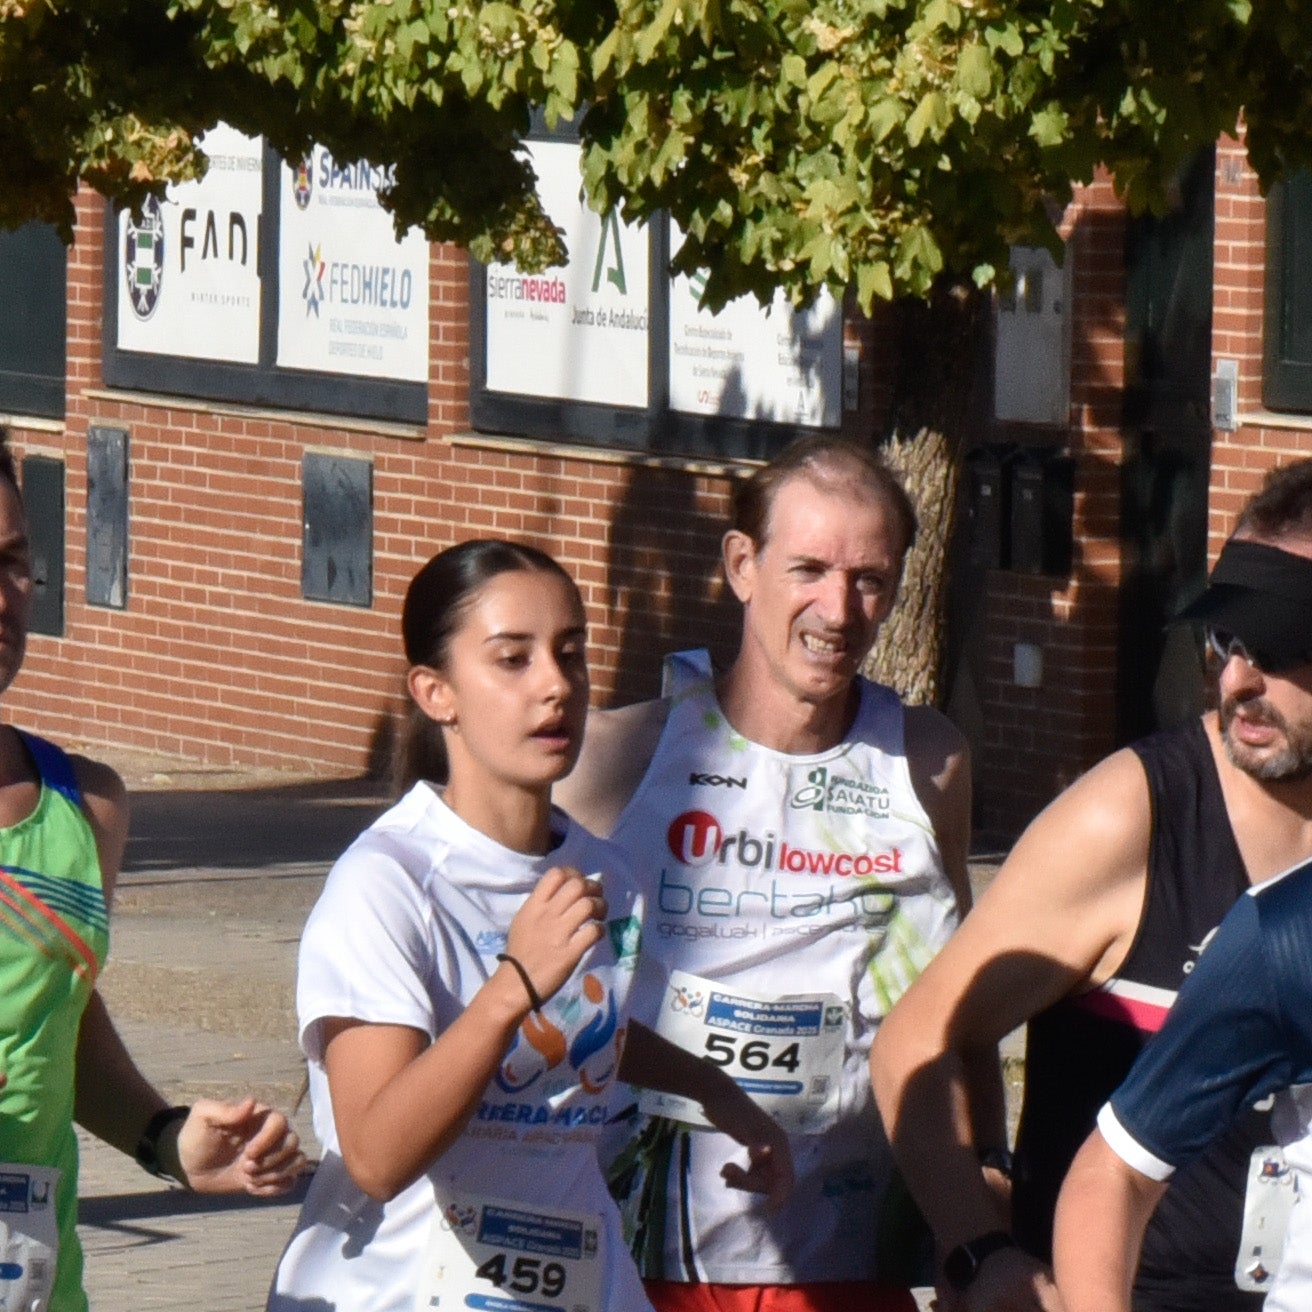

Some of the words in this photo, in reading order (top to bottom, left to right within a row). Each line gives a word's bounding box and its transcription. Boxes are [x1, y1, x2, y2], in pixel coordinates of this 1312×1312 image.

[329, 262, 413, 310] FEDHIELO
[572, 306, 594, 326] Junta
[596, 308, 606, 327] de
[609, 308, 649, 331] Andalucí
[708, 1015, 752, 1033] ASPACE
[704, 1032, 801, 1074] 564
[475, 1253, 566, 1298] 459
